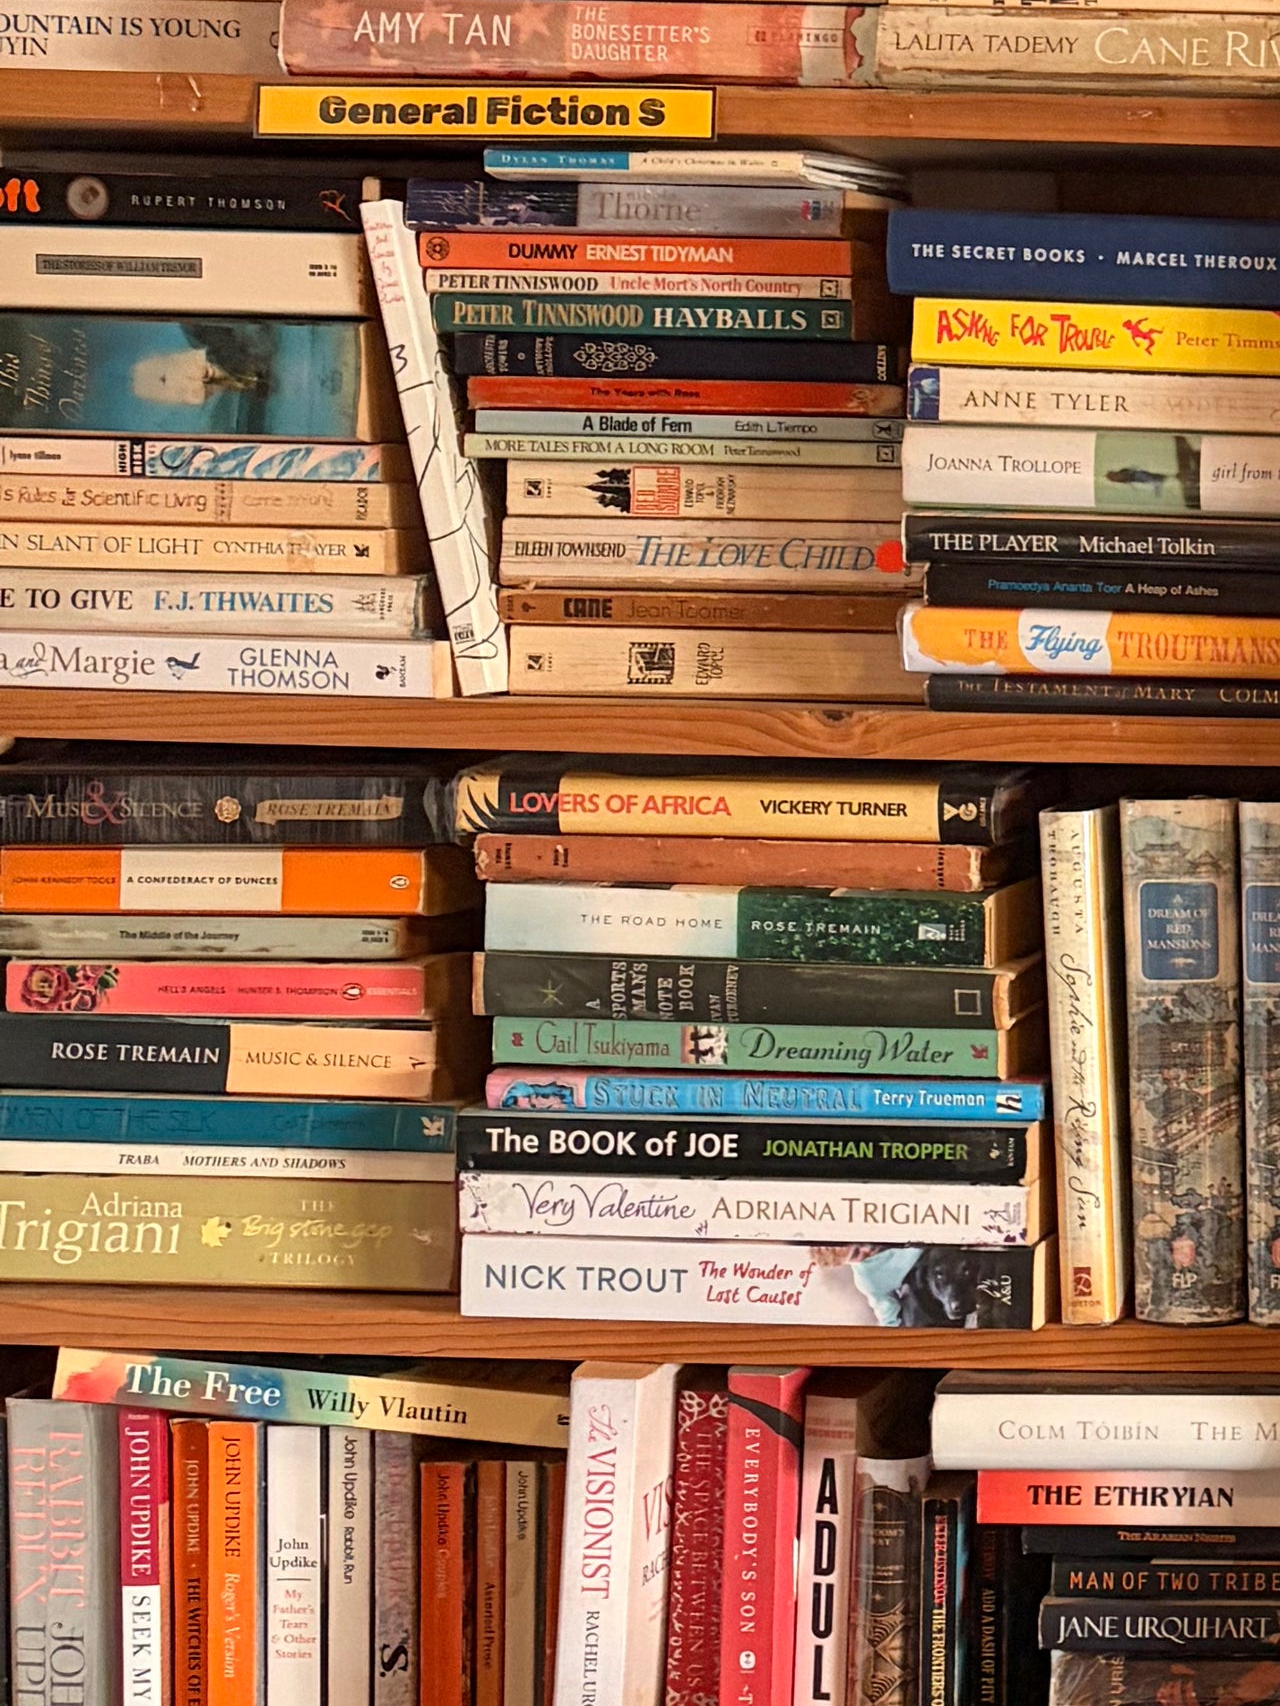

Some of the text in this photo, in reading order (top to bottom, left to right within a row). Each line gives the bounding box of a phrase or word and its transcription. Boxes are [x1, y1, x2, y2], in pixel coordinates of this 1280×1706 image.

[319, 96, 666, 127] General Fiction S
[508, 243, 733, 263] DUMMY ERNEST TIDYMAN
[912, 243, 1085, 264] THE SECRET BOOKS
[964, 388, 1129, 412] ANNE TYLER
[930, 533, 1058, 552] THE PLAYER
[510, 792, 732, 817] LOVERS OF AFRICA
[138, 876, 278, 886] CONFEDERACY OF DUNCES
[487, 1128, 738, 1159] The BOOK of JOE
[762, 1138, 969, 1162] JONATHAN TROPPER
[485, 1265, 688, 1293] NICK TROUT
[125, 1365, 468, 1426] The Free Willy Vlautin
[1027, 1483, 1234, 1510] THE ETHRYIAN
[582, 1446, 612, 1599] VISIONIST
